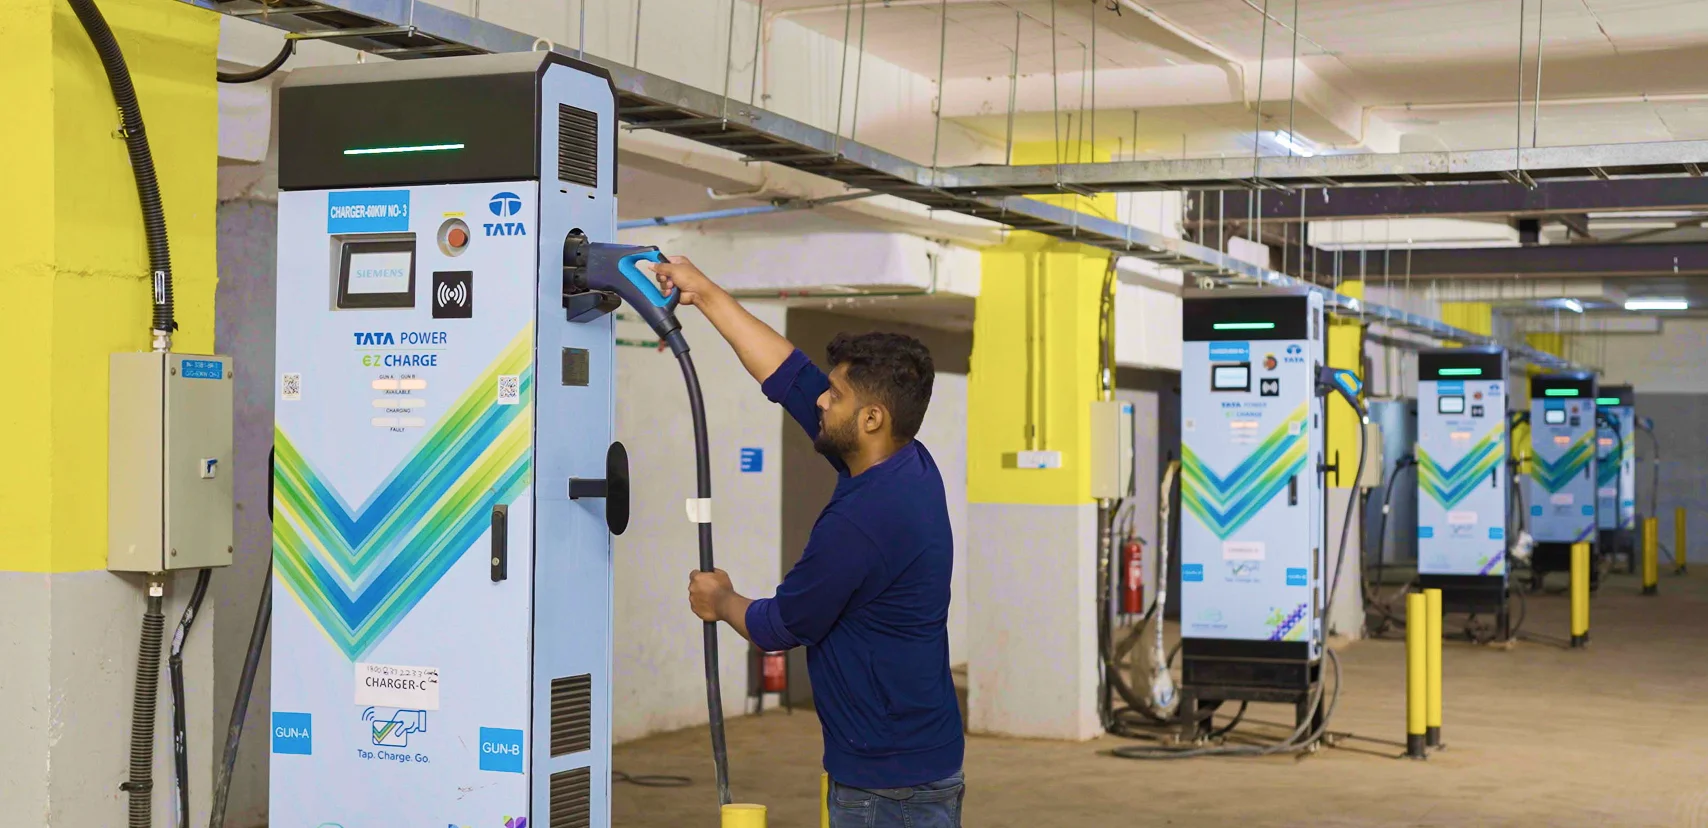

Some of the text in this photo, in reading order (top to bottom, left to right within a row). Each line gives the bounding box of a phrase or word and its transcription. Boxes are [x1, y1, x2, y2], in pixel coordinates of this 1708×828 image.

[402, 203, 408, 218] 3
[483, 222, 527, 237] TATA
[356, 268, 404, 279] SIEMENS
[354, 331, 448, 345] TATA POWER
[384, 354, 438, 367] CHARGE
[365, 676, 427, 691] CHARGER-C
[275, 726, 310, 740] GUN-A
[482, 742, 521, 756] GUN-B
[357, 749, 431, 764] Tap. Charge. Go.
